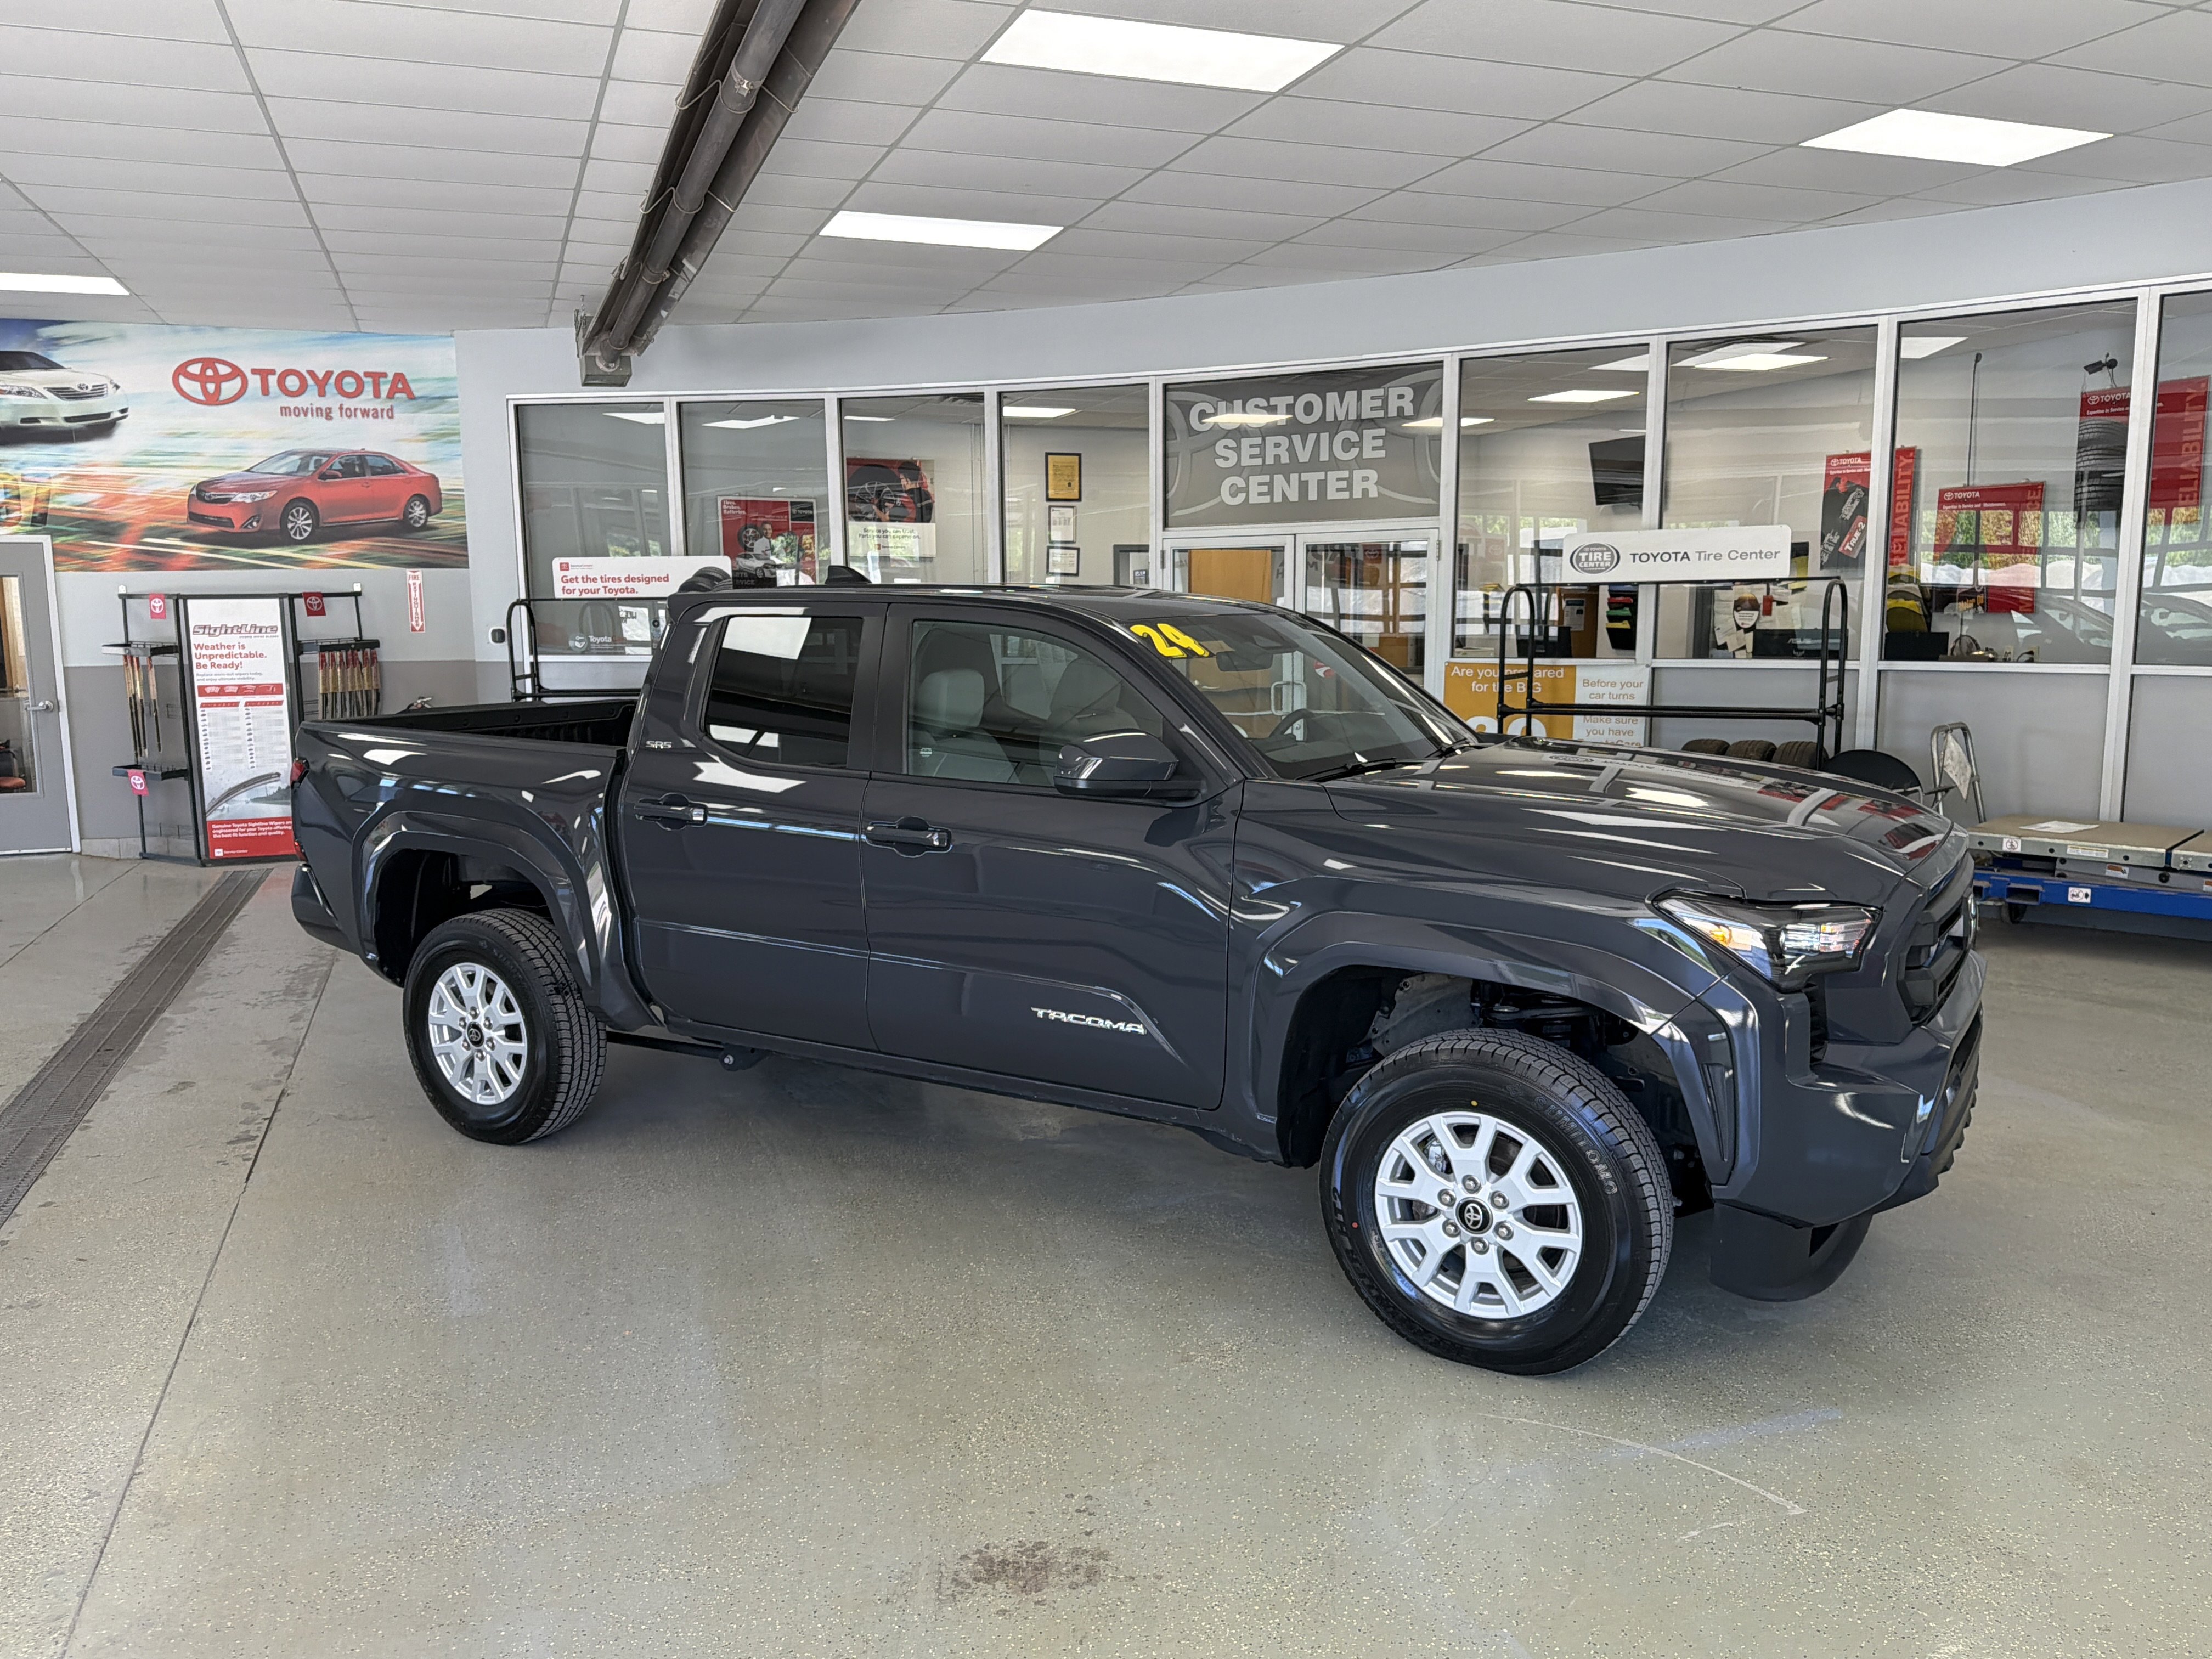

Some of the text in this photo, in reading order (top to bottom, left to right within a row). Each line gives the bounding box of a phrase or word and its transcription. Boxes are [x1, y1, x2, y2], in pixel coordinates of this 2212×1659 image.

[251, 368, 416, 400] TOYOTA
[2100, 392, 2131, 403] TOYOTA
[279, 402, 394, 421] moving forward
[1188, 386, 1415, 432] CUSTOMER
[1214, 428, 1386, 469] SERVICE
[1839, 456, 1861, 465] TOYOTA
[1220, 469, 1379, 506] CENTER
[1953, 490, 1980, 499] TOYOTA
[1579, 551, 1611, 561] TIRE
[1629, 548, 1781, 563] TOYOTA Tire Center
[561, 573, 669, 585] Get the tires designed
[561, 585, 639, 597] for your Toyota.
[193, 641, 246, 651] Weather is
[1129, 623, 1210, 658] 24
[194, 650, 268, 662] Unpredictable.
[195, 661, 243, 671] Be Ready!
[1451, 665, 1565, 680] Are you preared
[1471, 681, 1543, 693] for te BG
[1582, 679, 1644, 690] Before your
[1608, 691, 1635, 701] turns
[1583, 715, 1612, 724] Make
[1585, 727, 1634, 737] you have
[1030, 1006, 1148, 1036] TACOMA
[1532, 1094, 1618, 1195] SUMITOMO
